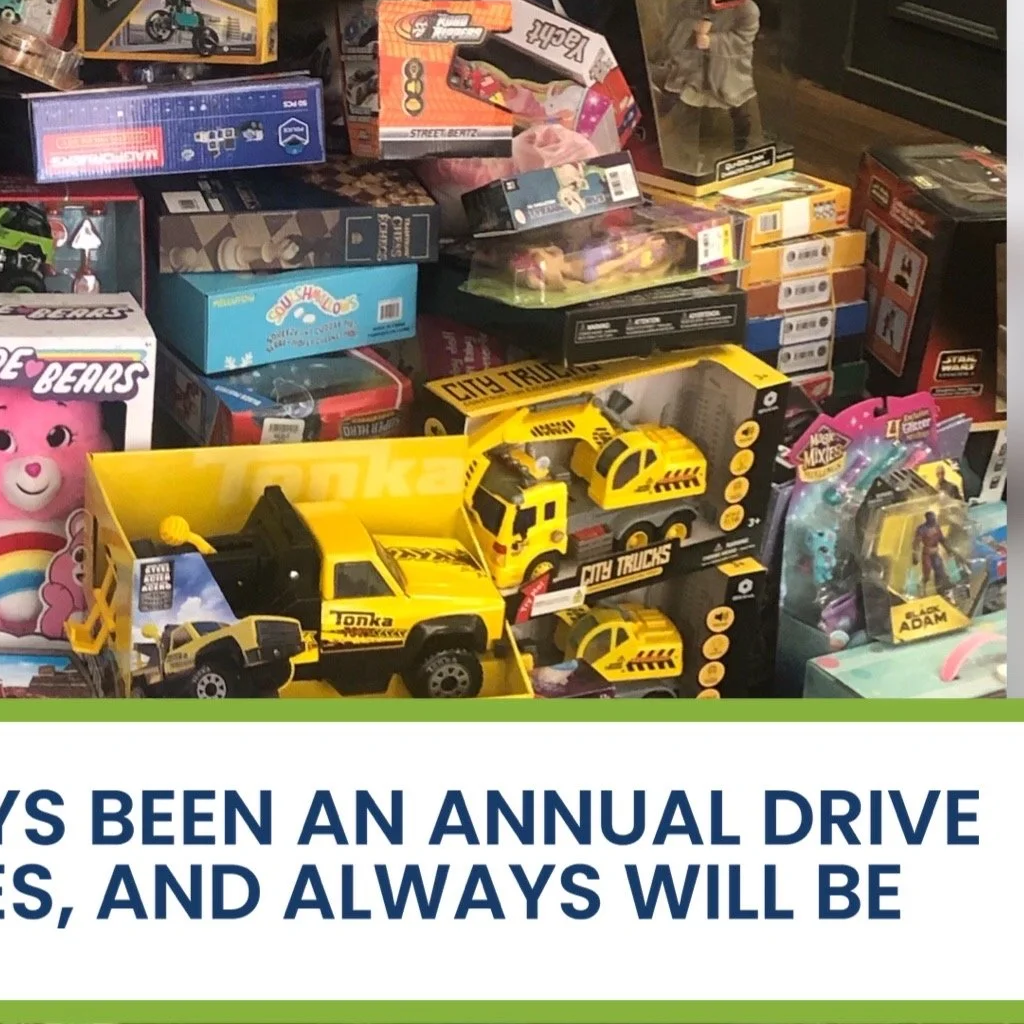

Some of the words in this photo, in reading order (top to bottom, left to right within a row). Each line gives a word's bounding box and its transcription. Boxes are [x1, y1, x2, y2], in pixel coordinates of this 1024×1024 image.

[526, 20, 590, 64] Yacht
[29, 307, 130, 319] BEARS
[32, 362, 148, 394] BEARS
[441, 376, 506, 402] CITY
[190, 443, 465, 503] Tonka
[580, 559, 613, 586] CITY
[616, 543, 672, 577] TRUCKS
[330, 610, 393, 627] Tonka
[899, 611, 947, 633] ADAM
[905, 604, 941, 619] BLACK
